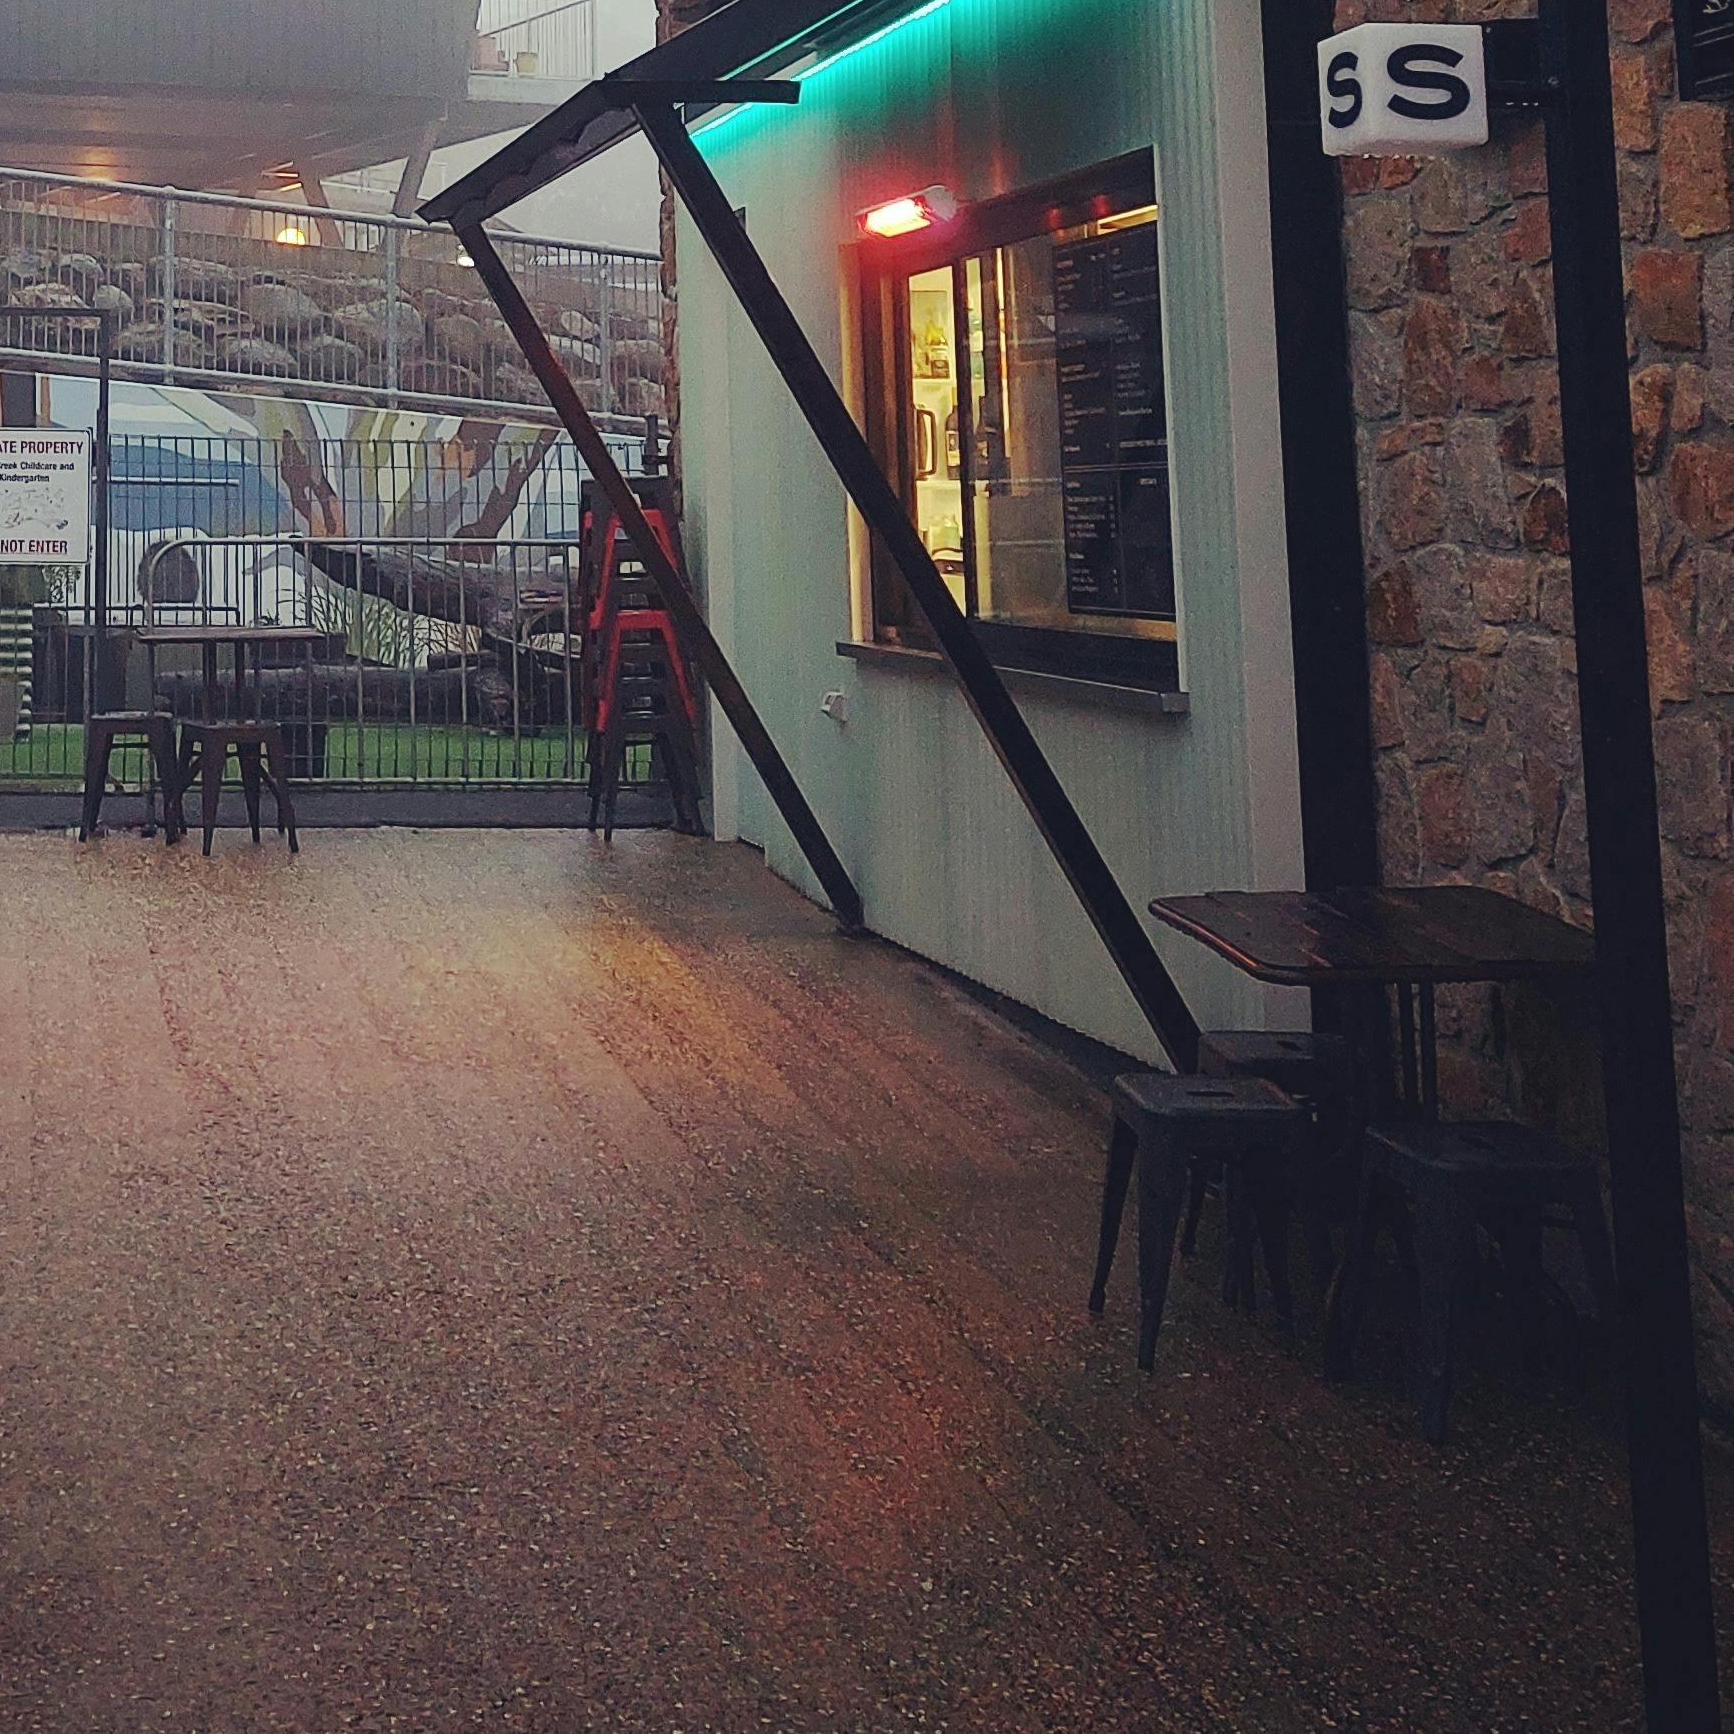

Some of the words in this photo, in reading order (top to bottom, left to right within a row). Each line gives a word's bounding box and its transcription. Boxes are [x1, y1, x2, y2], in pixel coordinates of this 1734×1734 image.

[20, 440, 84, 455] PROPERTY
[20, 460, 58, 471] Childcare
[59, 460, 75, 471] and
[0, 539, 25, 553] NOT
[28, 540, 68, 554] ENTER
